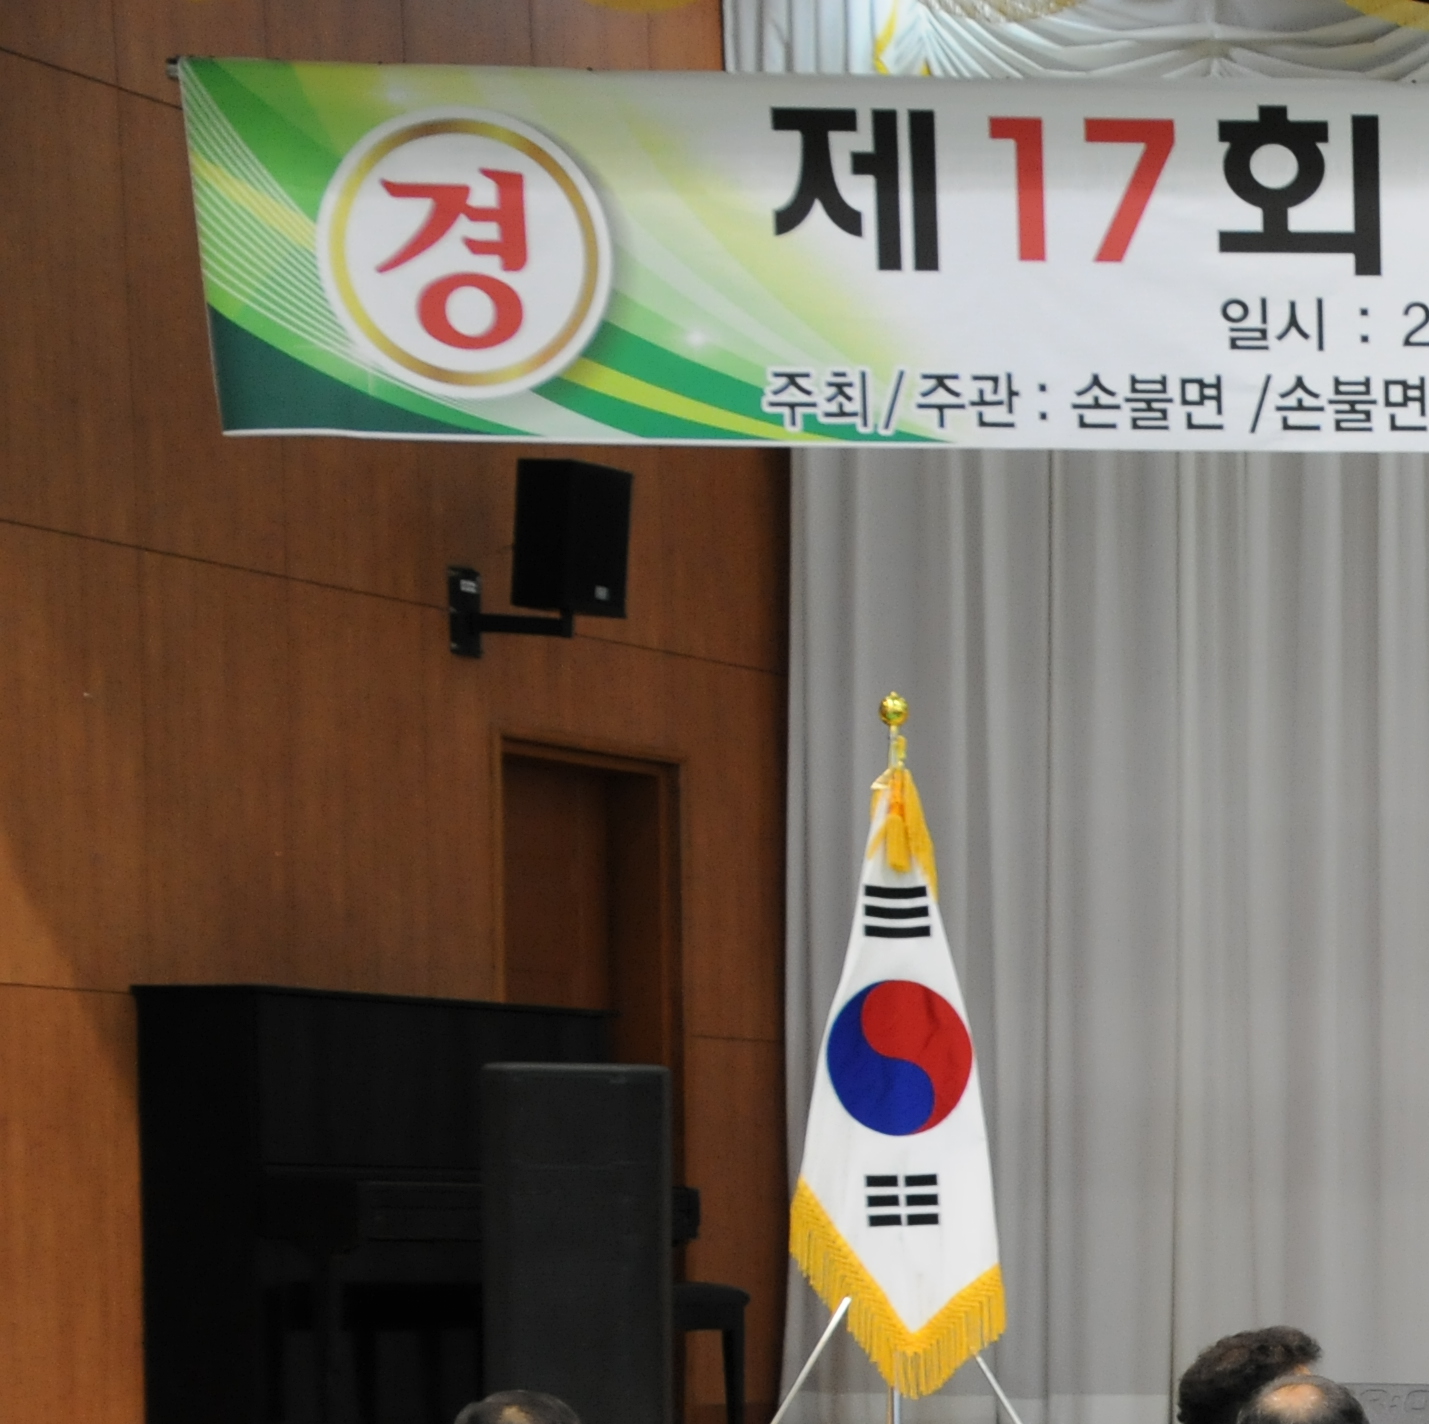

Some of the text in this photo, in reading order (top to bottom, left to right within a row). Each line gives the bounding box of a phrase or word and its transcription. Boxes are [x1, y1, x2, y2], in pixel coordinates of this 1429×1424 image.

[379, 169, 529, 350] 경
[1221, 298, 1324, 351] 일시
[1072, 374, 1224, 430] 손불면
